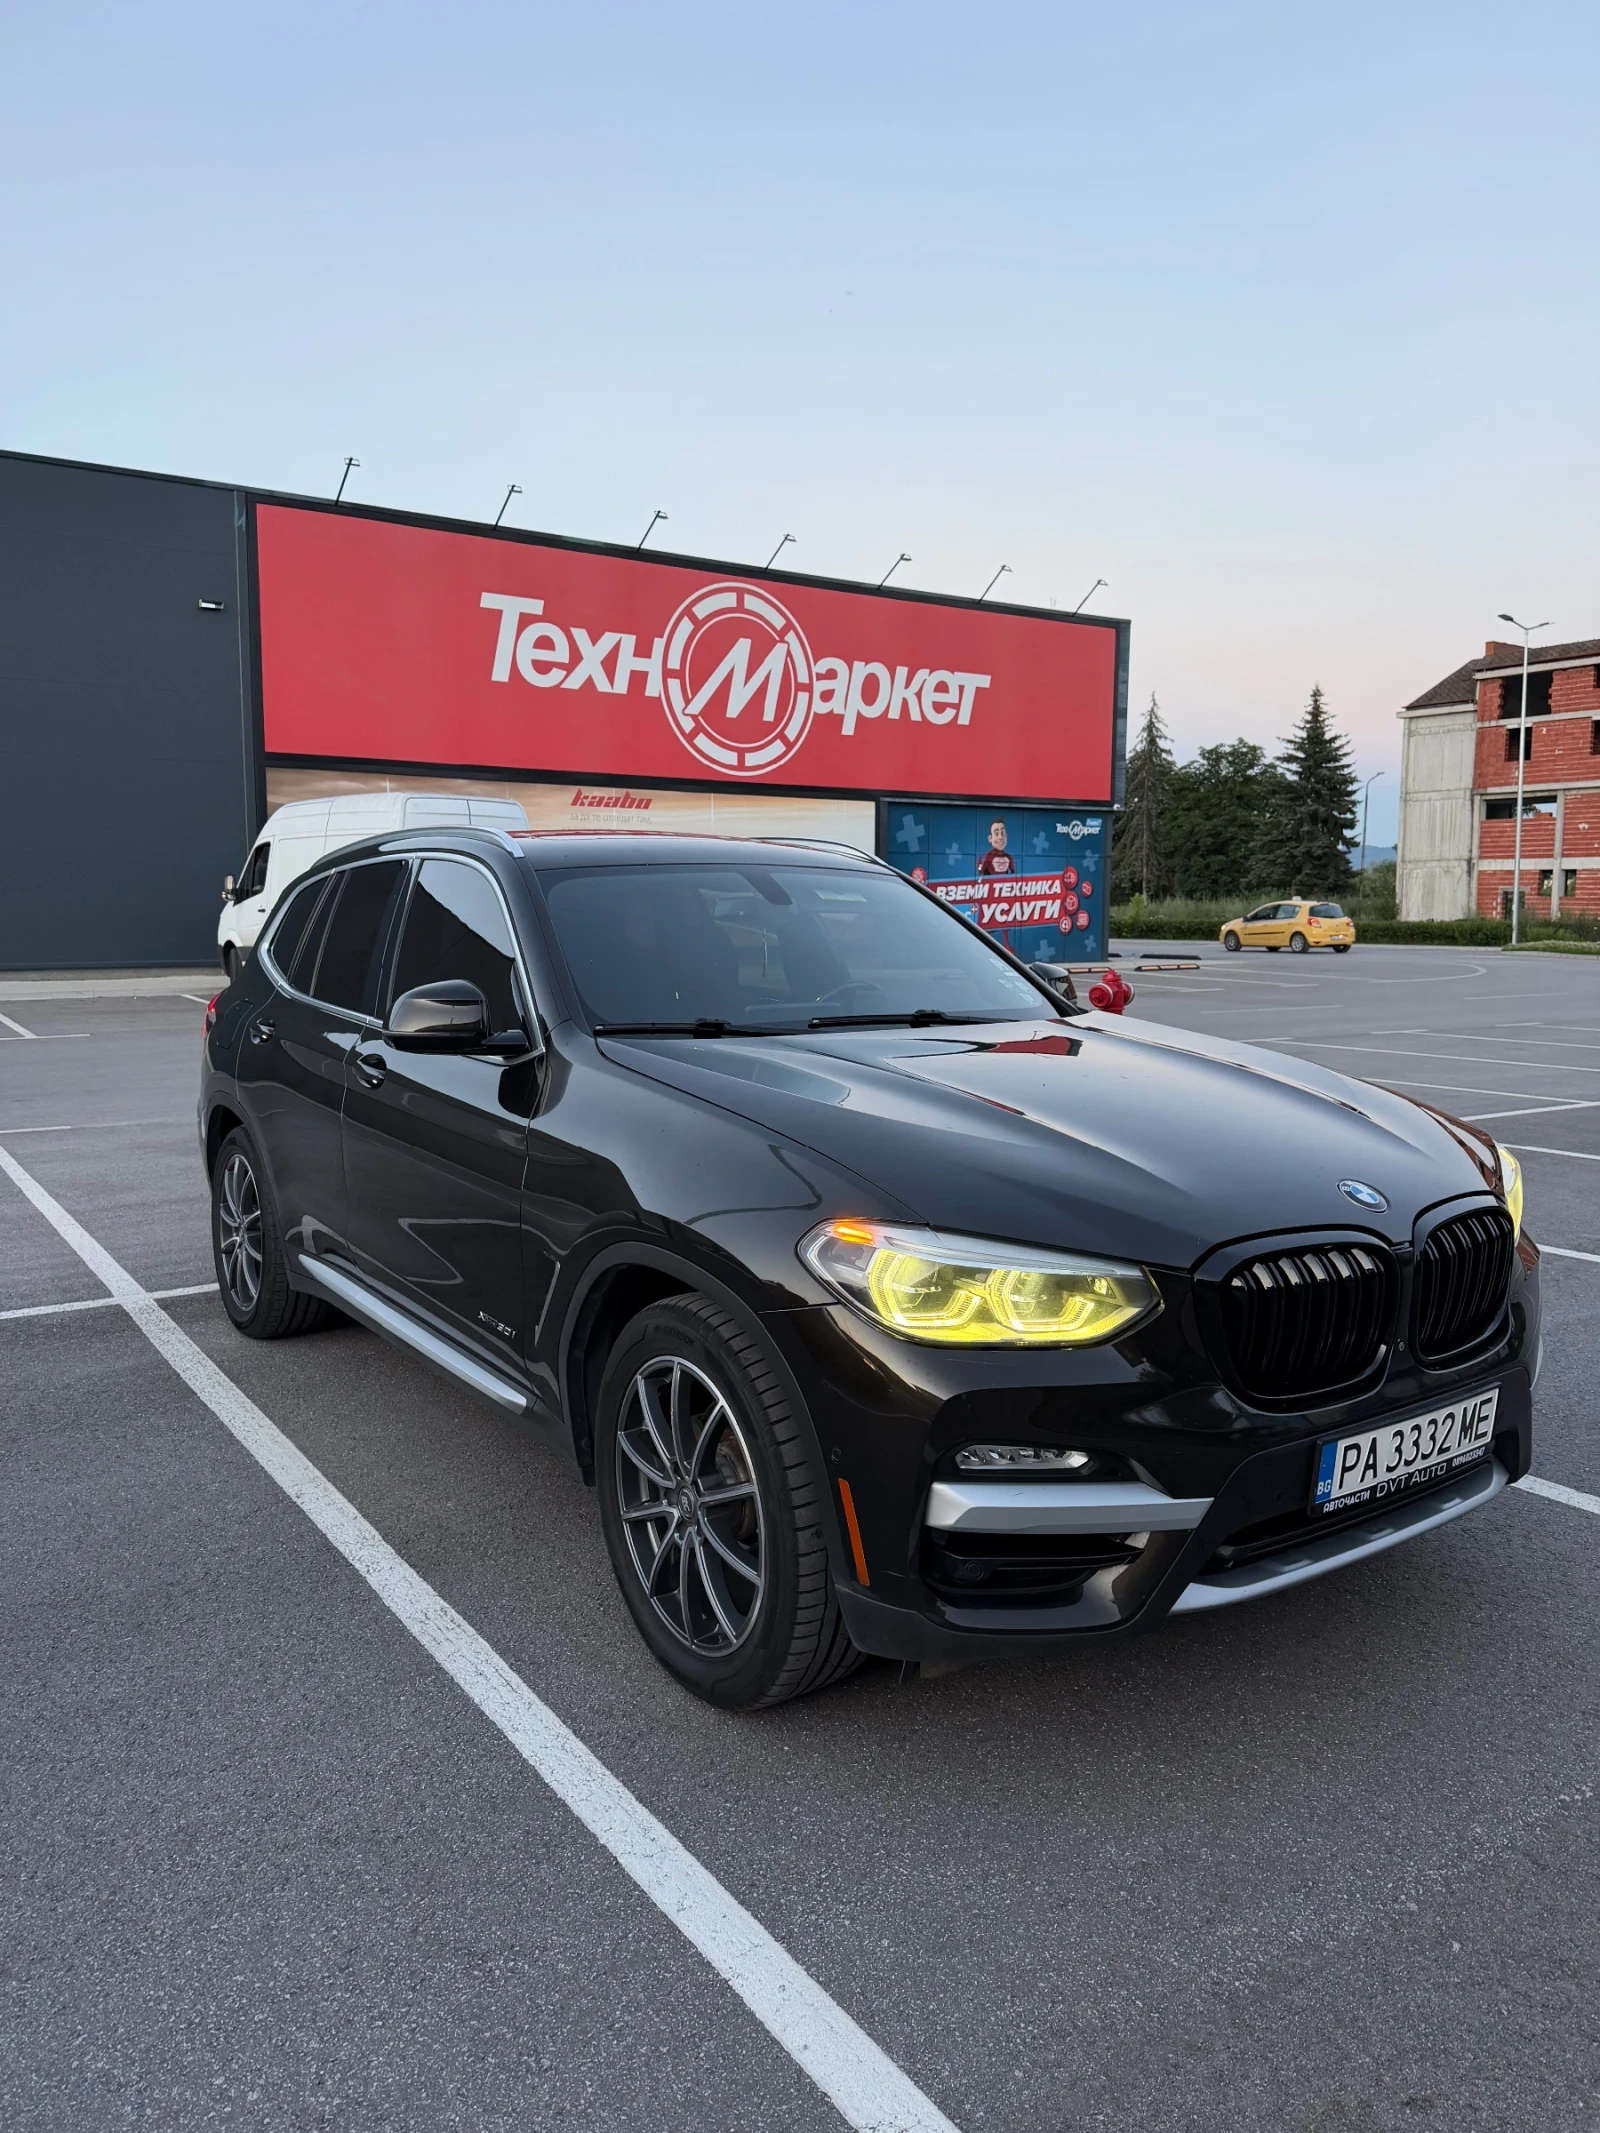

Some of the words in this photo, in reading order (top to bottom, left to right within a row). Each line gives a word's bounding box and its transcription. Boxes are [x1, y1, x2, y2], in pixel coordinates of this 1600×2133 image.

[570, 787, 653, 810] kaabo
[935, 883, 990, 901] ВЗЕМИ
[993, 880, 1062, 898] ТЕХНИКА
[981, 899, 1062, 924] УСЛУГИ
[1385, 1412, 1456, 1473] 3332
[1317, 1480, 1331, 1495] BG
[1323, 1490, 1371, 1513] АВТОЧАСТИ
[1376, 1474, 1408, 1498] DVT
[1410, 1462, 1447, 1486] AUTO
